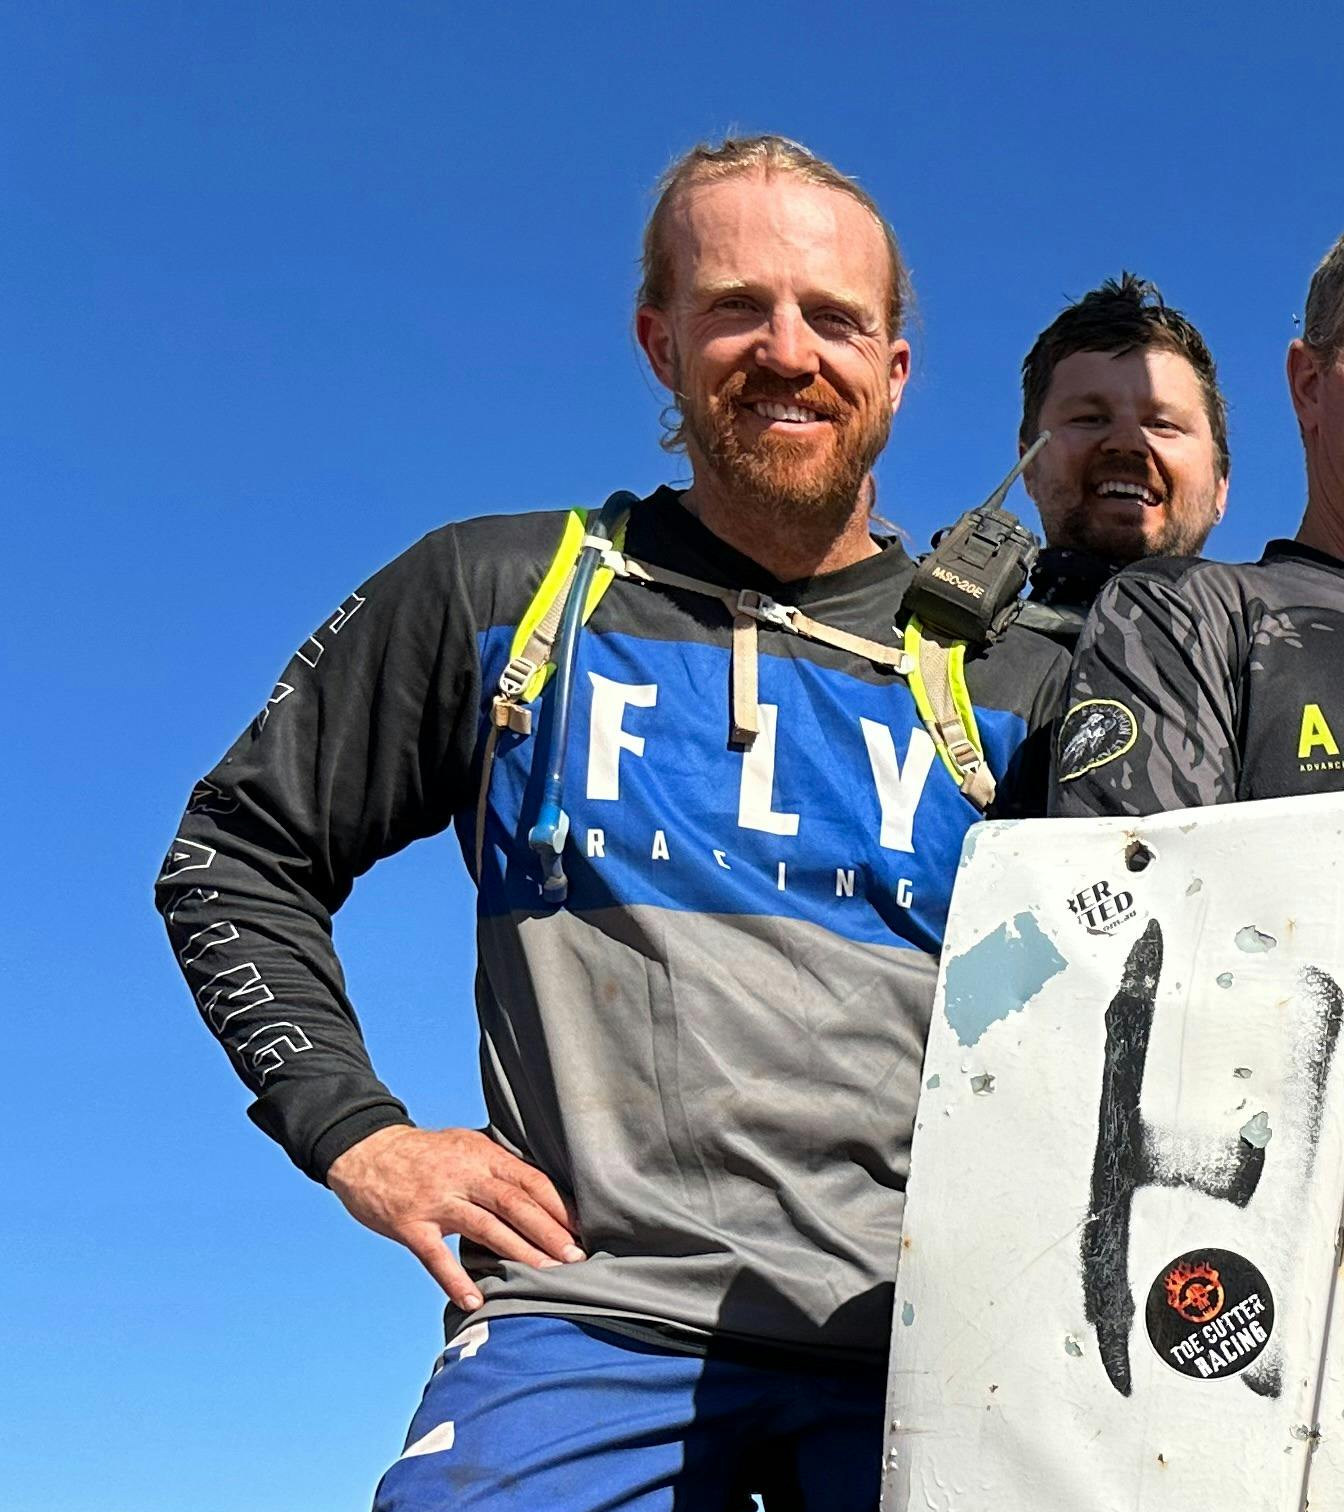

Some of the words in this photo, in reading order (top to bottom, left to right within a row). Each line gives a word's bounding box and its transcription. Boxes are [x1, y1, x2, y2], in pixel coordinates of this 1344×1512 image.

[586, 671, 937, 853] FLY
[1066, 880, 1112, 914] ER
[1077, 891, 1133, 928] TED
[1170, 1332, 1205, 1365] TOE
[1201, 1293, 1266, 1344] CUTTER
[1193, 1320, 1268, 1378] RACING
